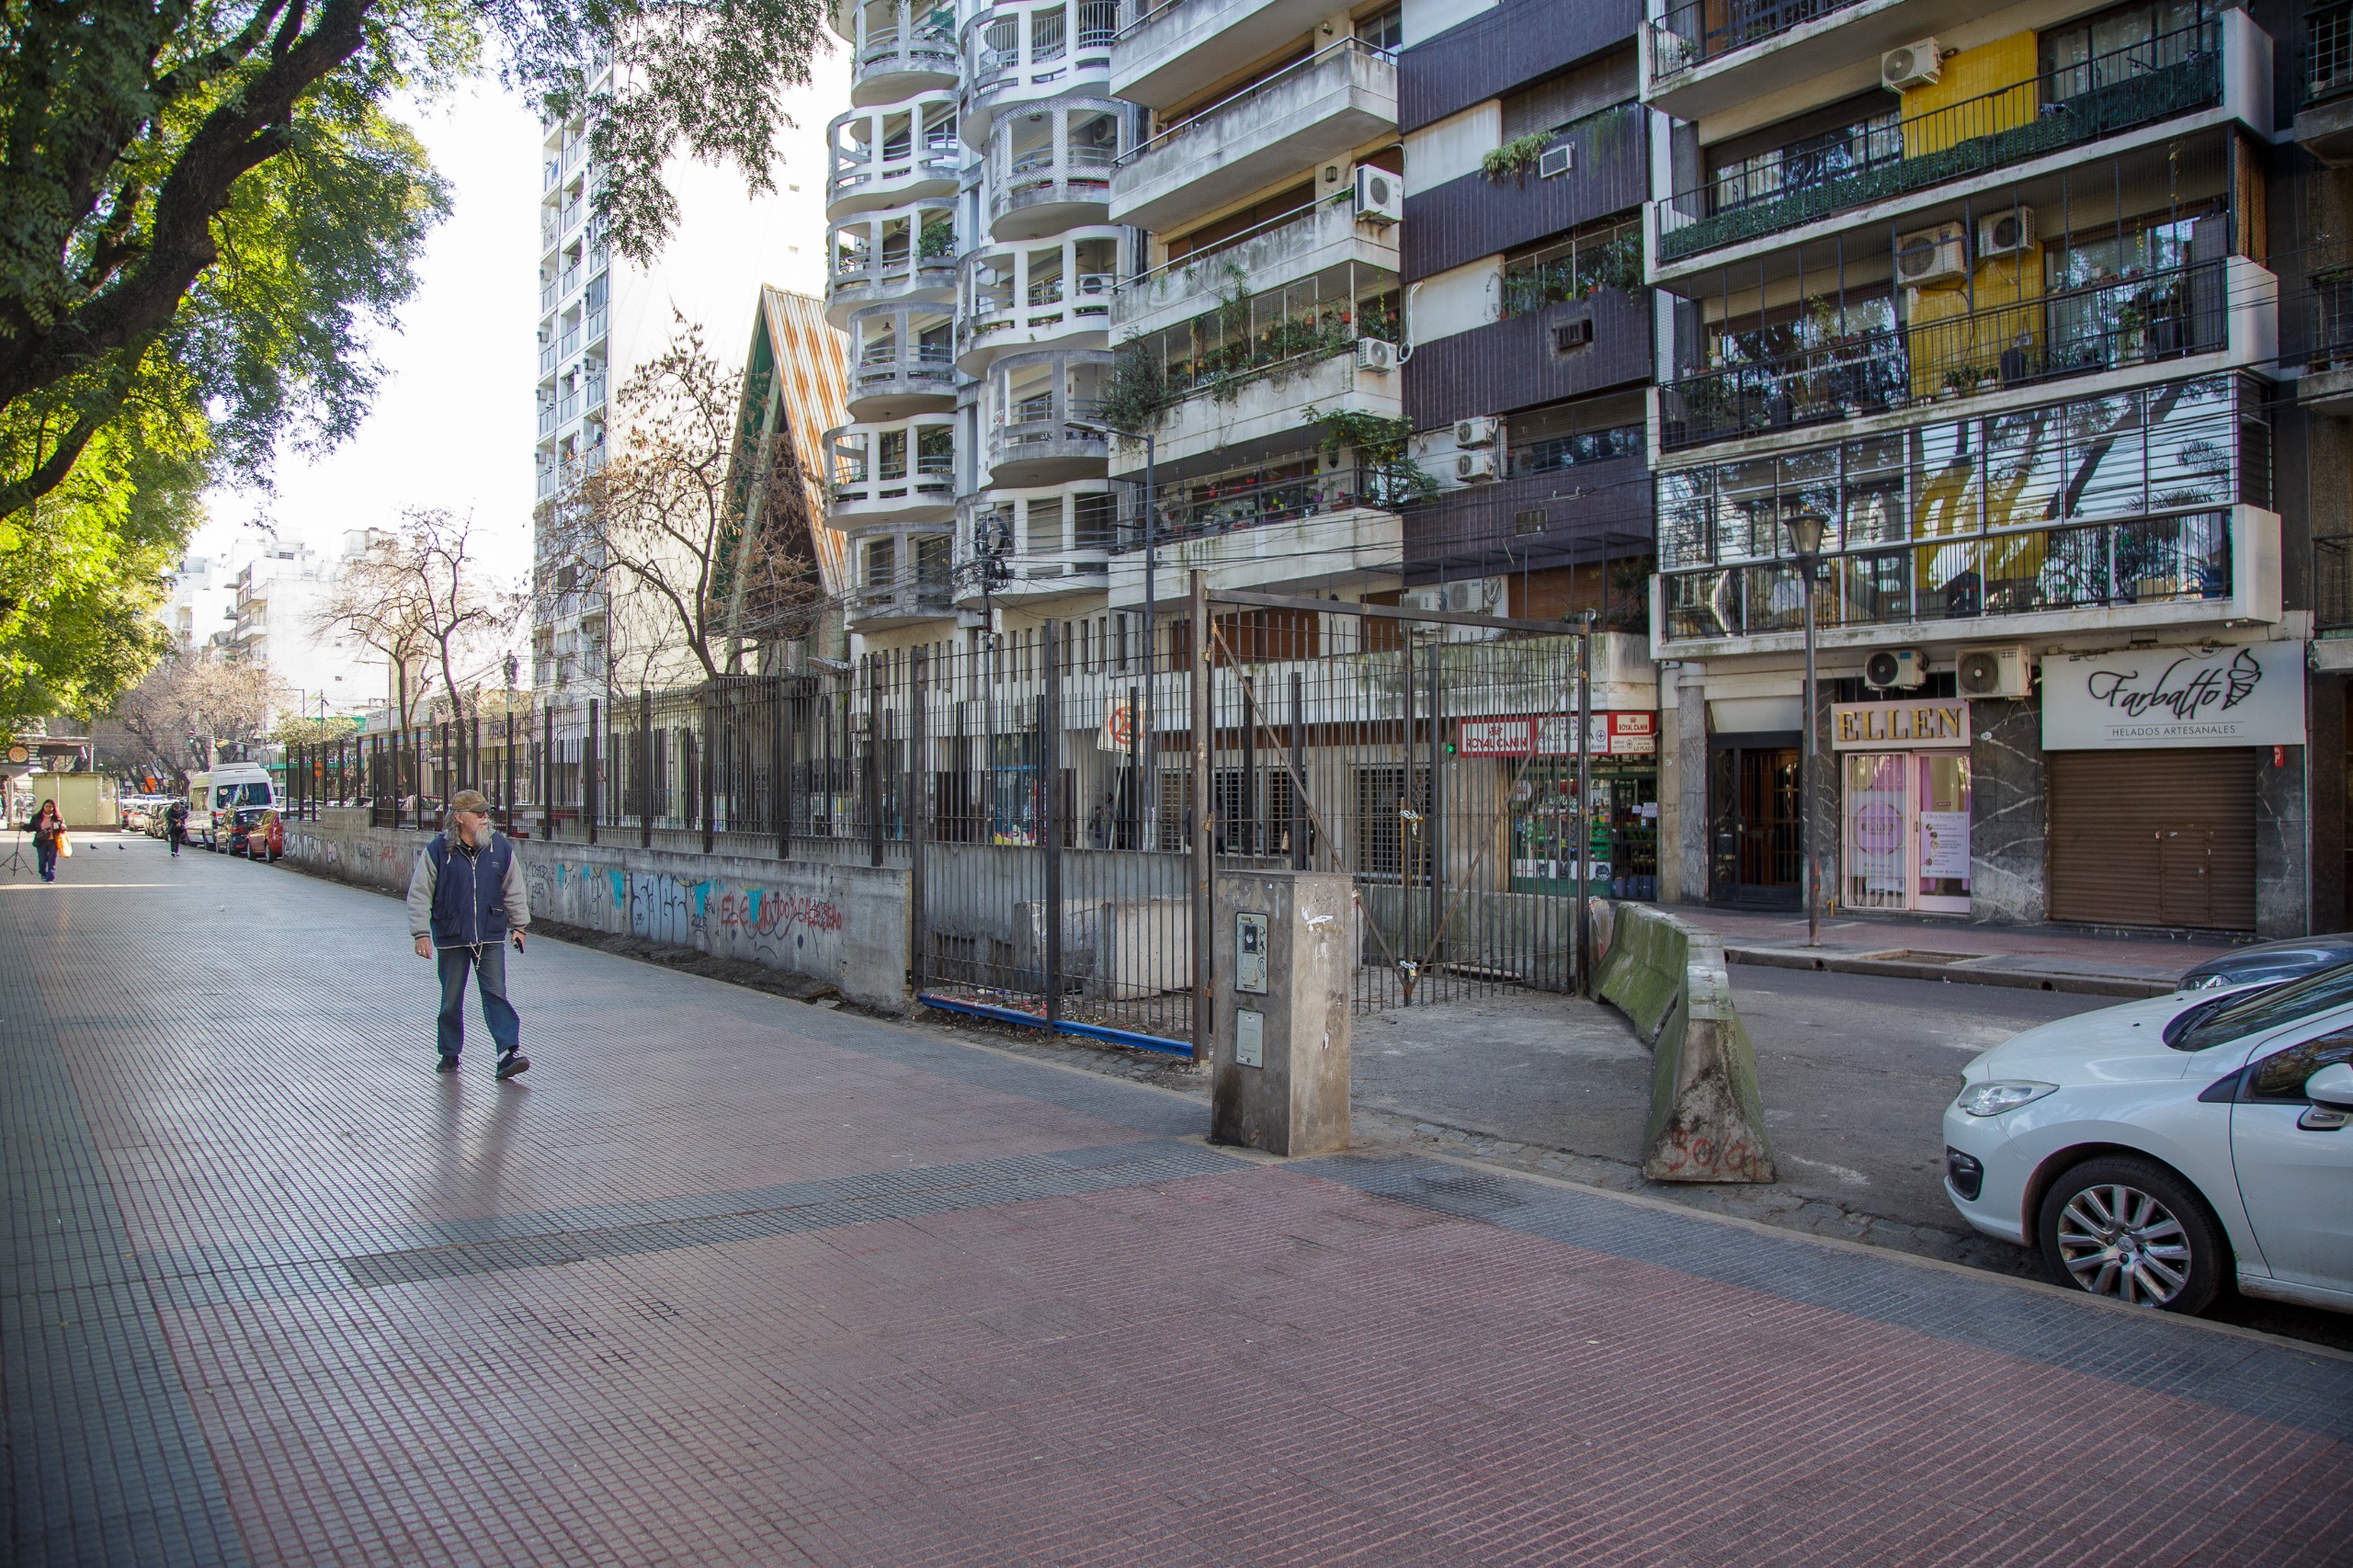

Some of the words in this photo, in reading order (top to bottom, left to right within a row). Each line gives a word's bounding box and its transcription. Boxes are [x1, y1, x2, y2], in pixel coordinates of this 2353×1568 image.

[2088, 657, 2222, 720] Farbatto
[1620, 723, 1632, 732] ROYAL
[1633, 723, 1648, 732] CANIN
[1836, 707, 1962, 742] ELLEN
[2112, 727, 2159, 736] HELADOS
[2164, 724, 2235, 735] ARTESANALES
[1467, 738, 1495, 748] ROYAL
[1496, 737, 1527, 747] CANIN
